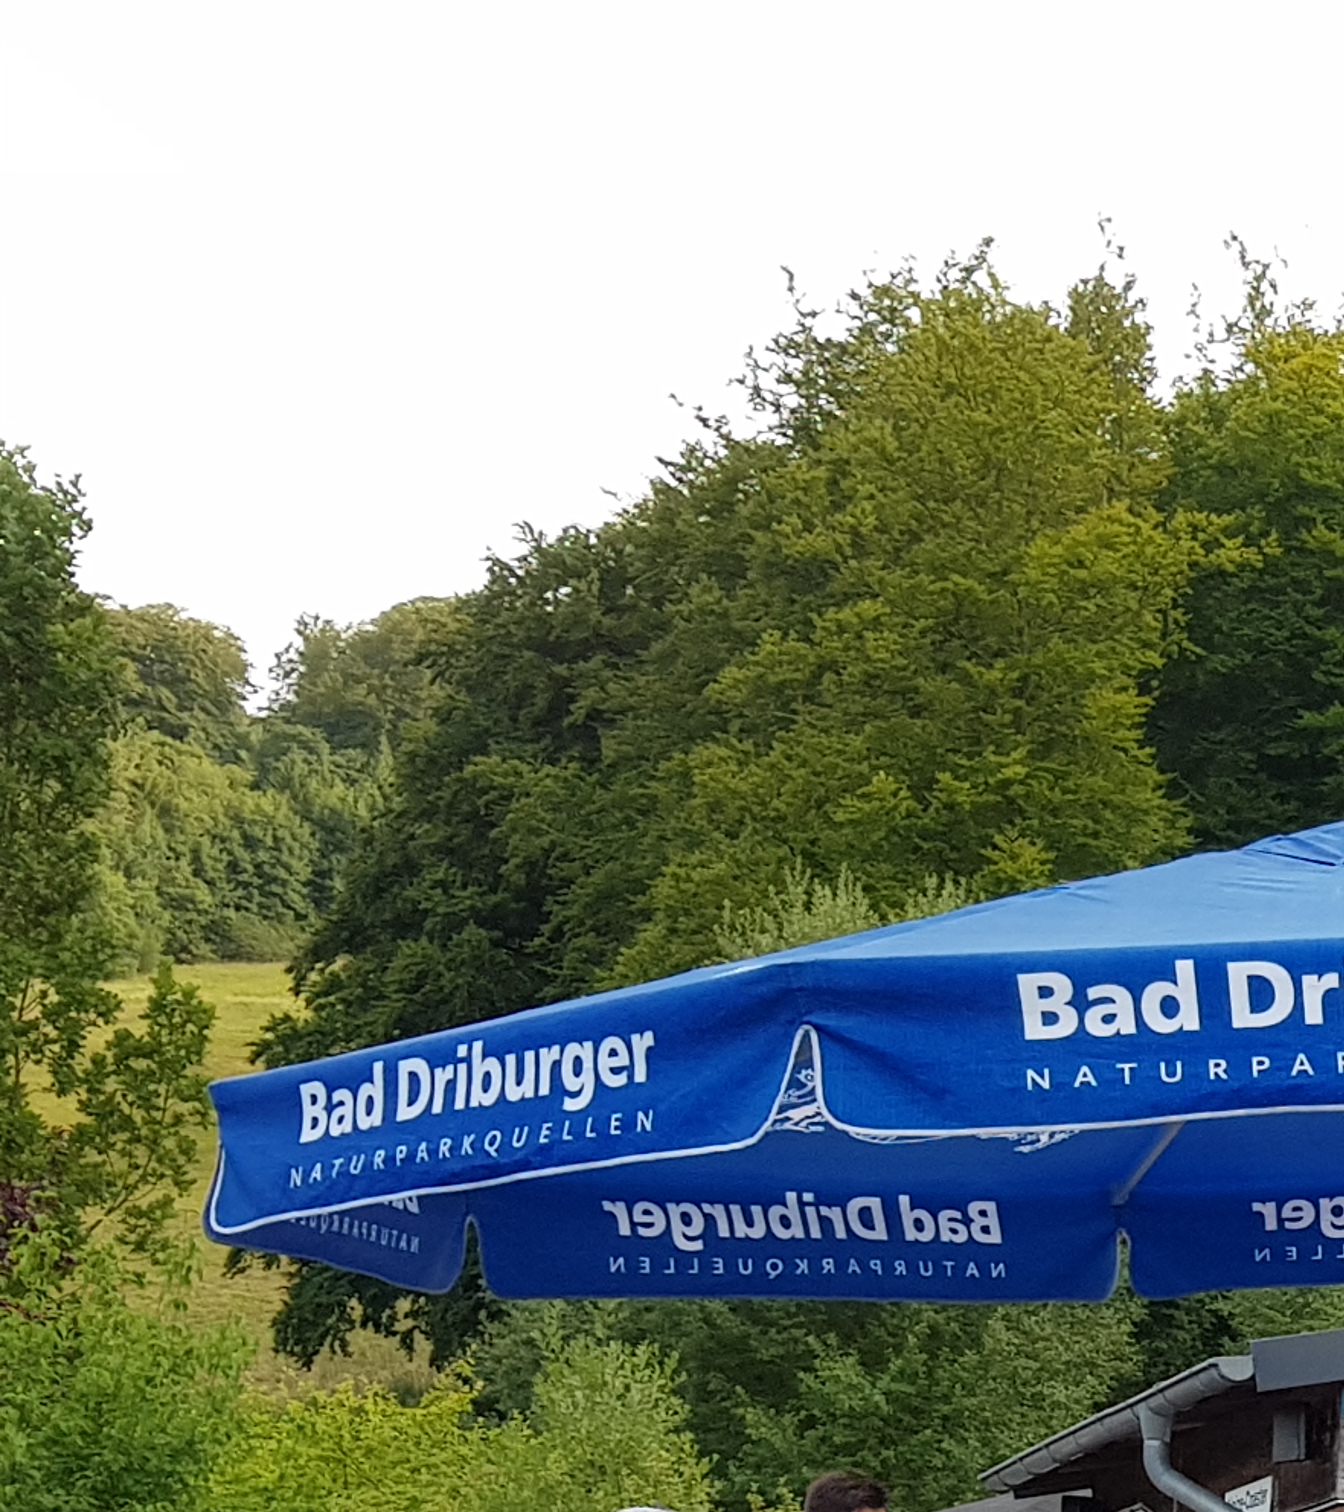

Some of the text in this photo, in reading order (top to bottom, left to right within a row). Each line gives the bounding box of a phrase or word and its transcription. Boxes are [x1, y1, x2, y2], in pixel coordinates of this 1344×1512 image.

[1017, 959, 1201, 1041] Bad
[299, 1031, 654, 1144] Bad Driburger
[289, 1109, 654, 1188] NATURPARKQUELLEN
